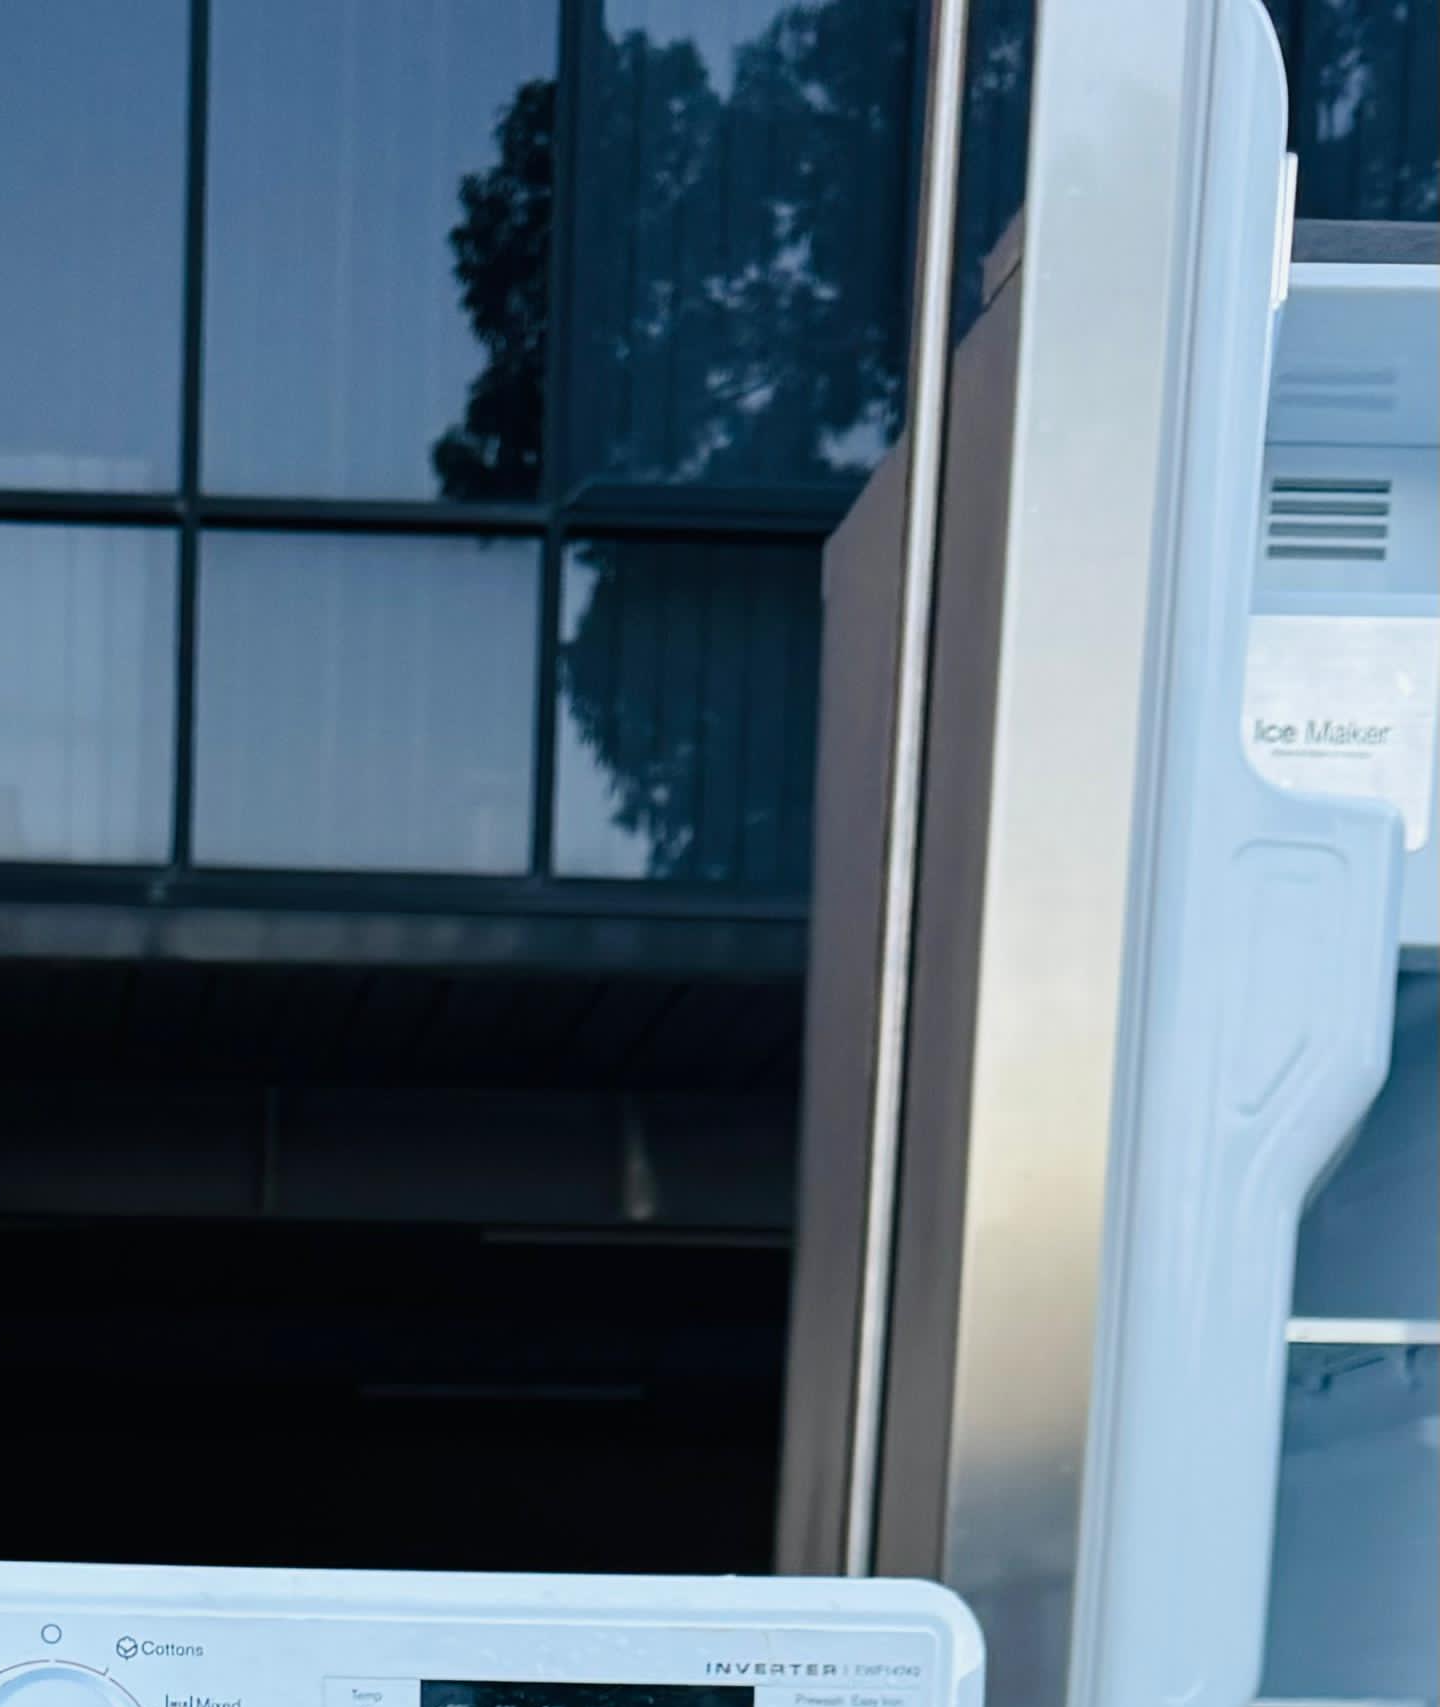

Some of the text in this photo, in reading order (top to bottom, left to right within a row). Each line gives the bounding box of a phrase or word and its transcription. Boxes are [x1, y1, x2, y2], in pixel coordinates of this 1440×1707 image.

[1253, 717, 1393, 745] Ice Maker
[141, 1640, 204, 1657] Cottons
[705, 1661, 837, 1677] INVERTER
